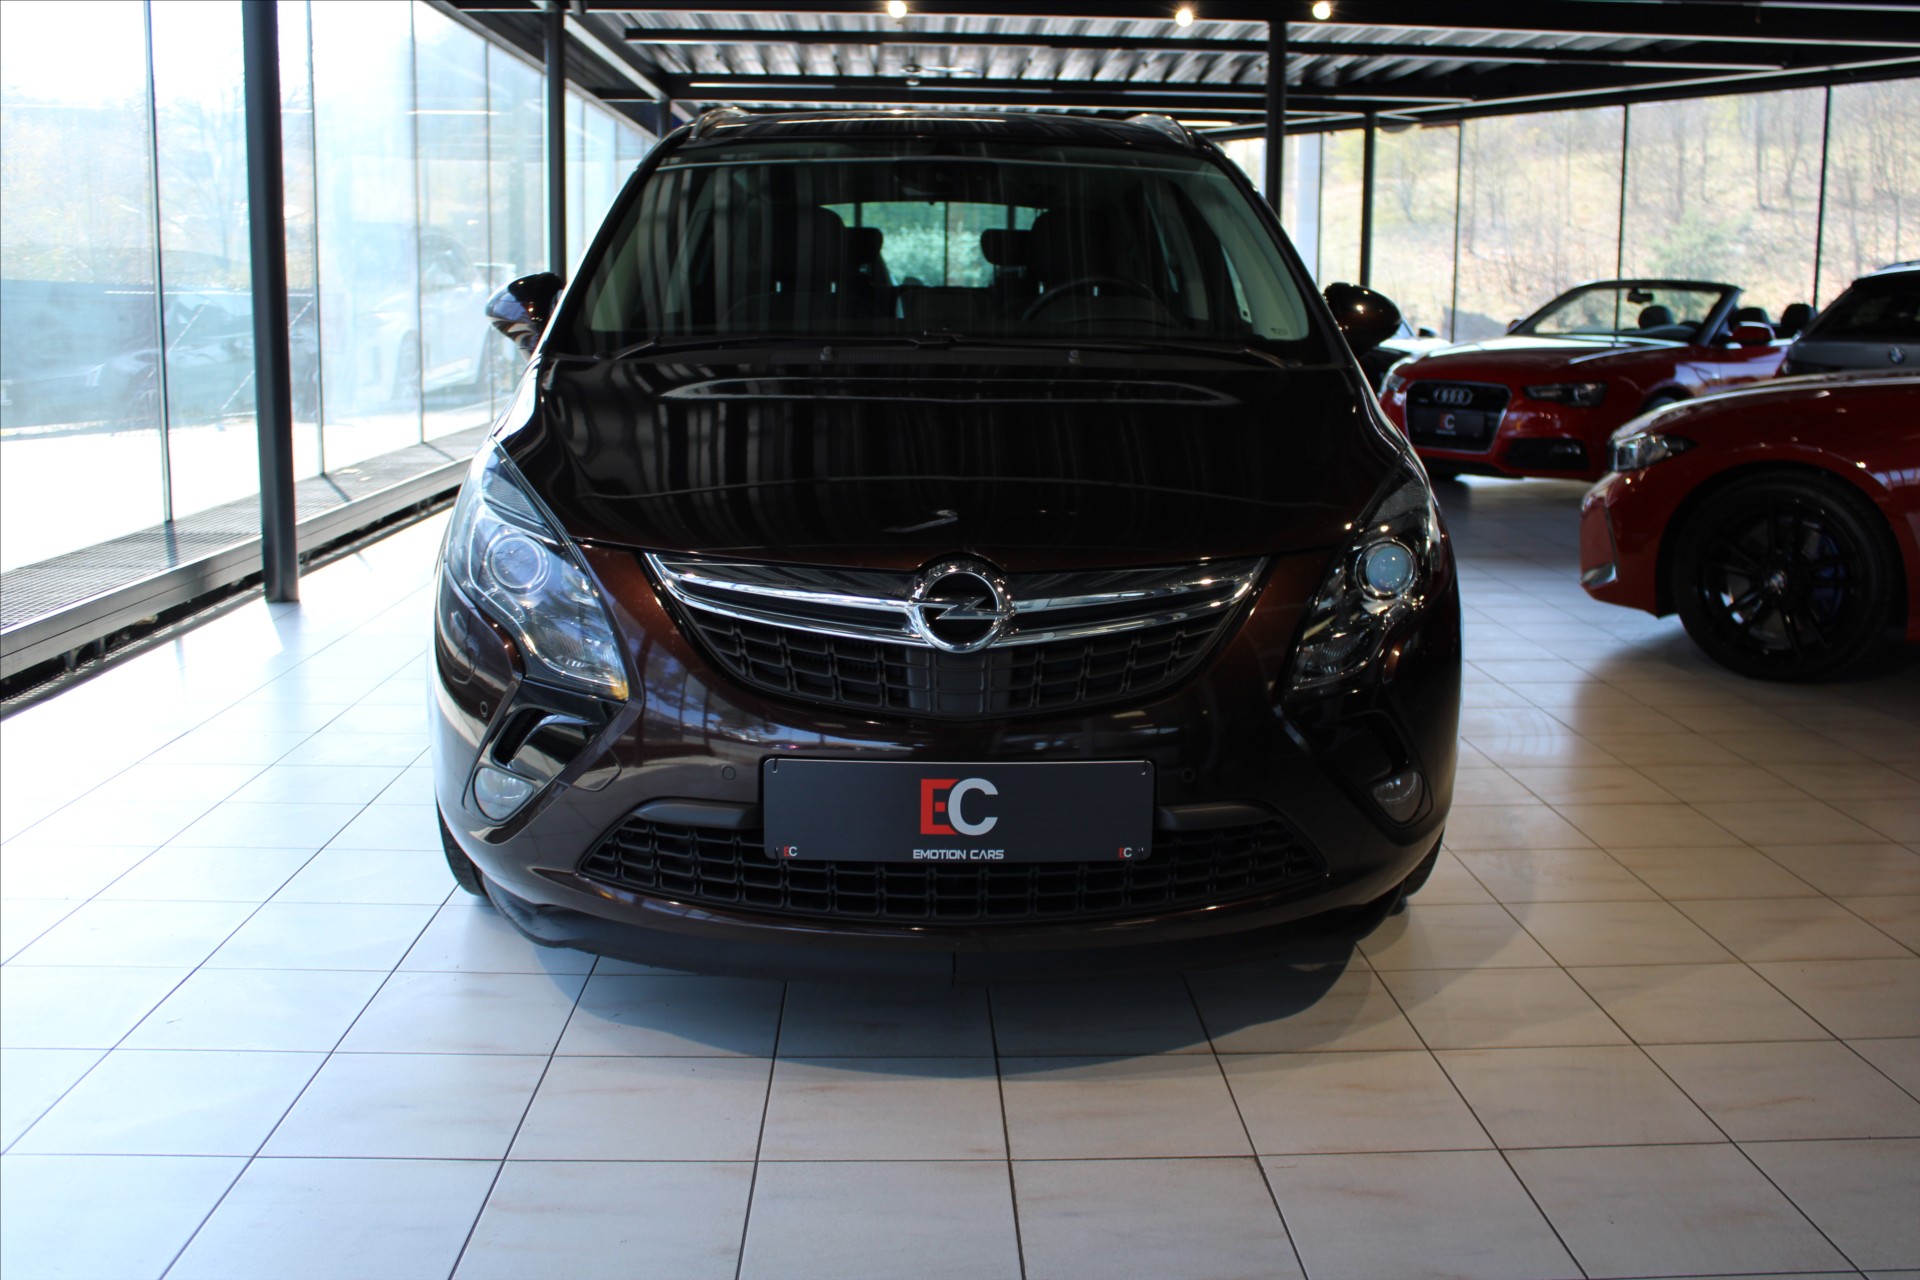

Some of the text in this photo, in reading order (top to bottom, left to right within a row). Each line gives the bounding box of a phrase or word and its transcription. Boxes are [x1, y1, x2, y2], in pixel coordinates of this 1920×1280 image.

[920, 777, 999, 836] EC
[783, 845, 798, 857] EC
[912, 849, 1005, 860] EMOTION CARS
[1118, 847, 1133, 859] EC
